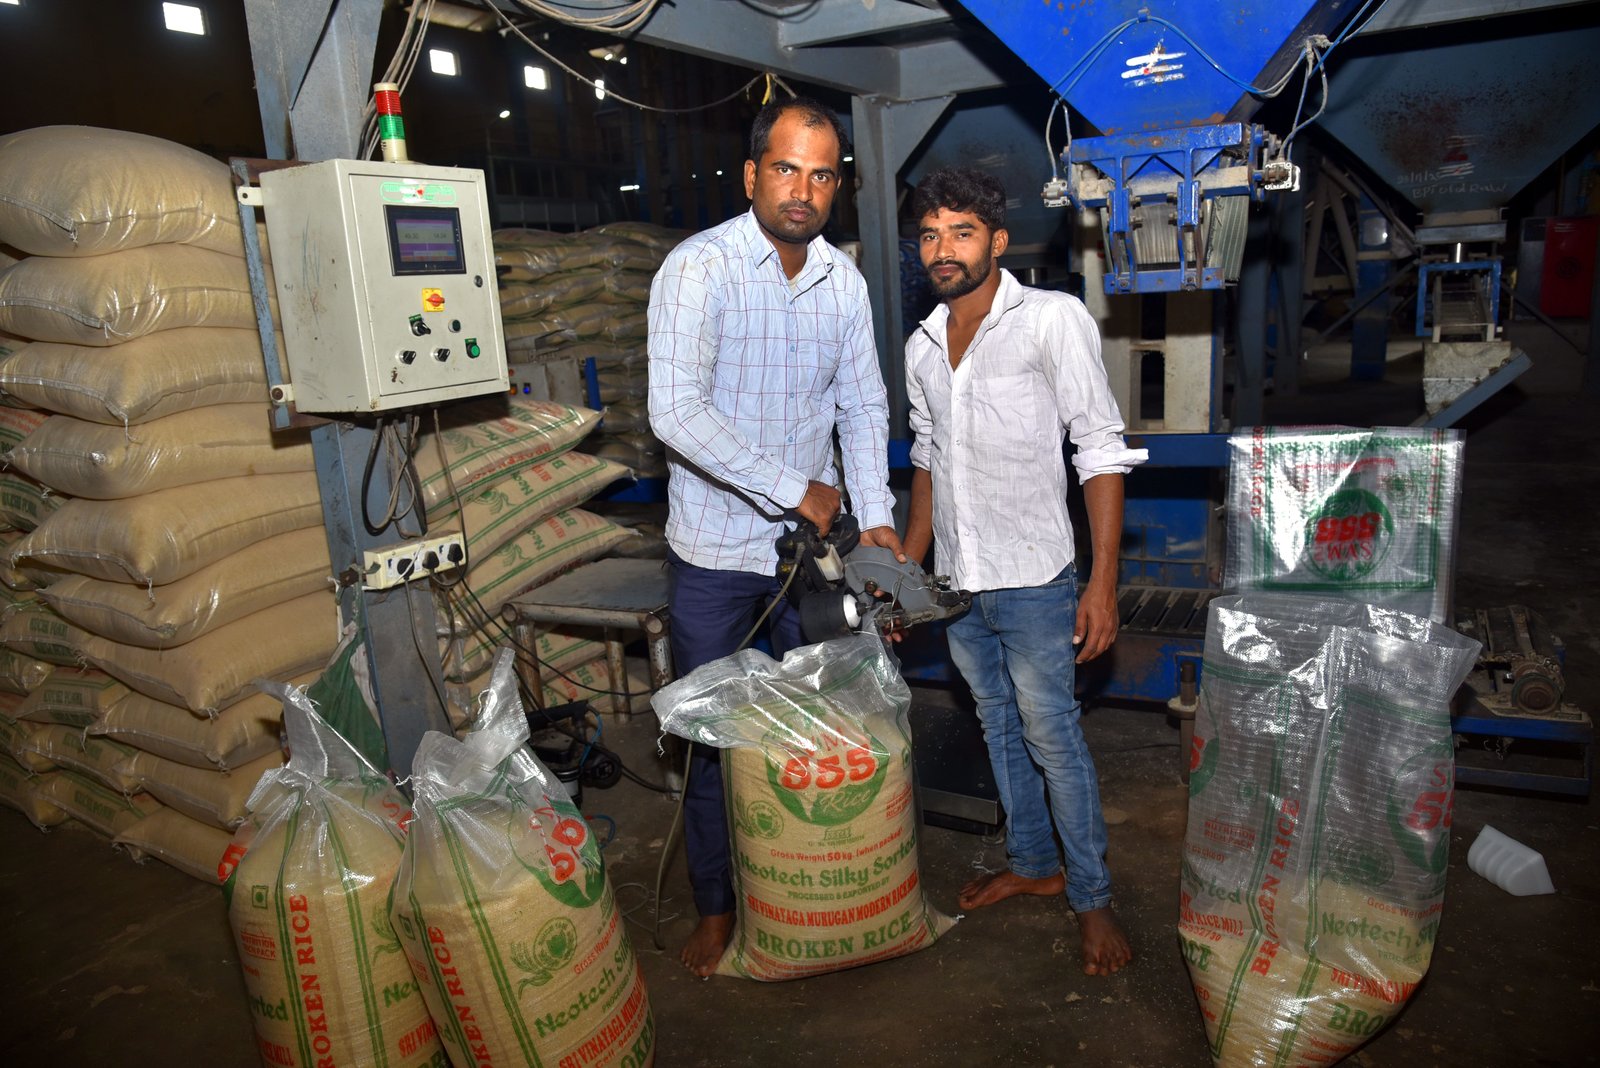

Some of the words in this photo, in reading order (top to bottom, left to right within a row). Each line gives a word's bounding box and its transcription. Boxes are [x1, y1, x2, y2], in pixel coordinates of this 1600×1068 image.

[781, 744, 876, 790] 555
[1204, 820, 1256, 842] NUTRITION
[1269, 797, 1300, 869] RICE
[740, 852, 814, 888] Neotech
[819, 866, 869, 888] Silky
[873, 828, 916, 876] Sorted
[770, 848, 795, 861] Gross
[795, 851, 826, 863] Weight
[827, 851, 841, 862] 50
[759, 897, 805, 927] VINAYAGA
[806, 910, 855, 927] MURUGAN
[856, 893, 892, 922] MODERN
[842, 879, 878, 899] EXPORTED
[1367, 896, 1399, 914] Gross
[289, 894, 316, 966] RICE
[756, 927, 853, 960] BROKEN
[863, 909, 912, 950] RICE
[1221, 916, 1245, 937] MILL
[1321, 911, 1411, 950] Neotech
[427, 926, 466, 997] RICE
[534, 967, 616, 1039] Neotech
[578, 1014, 625, 1065] VINAYAGA
